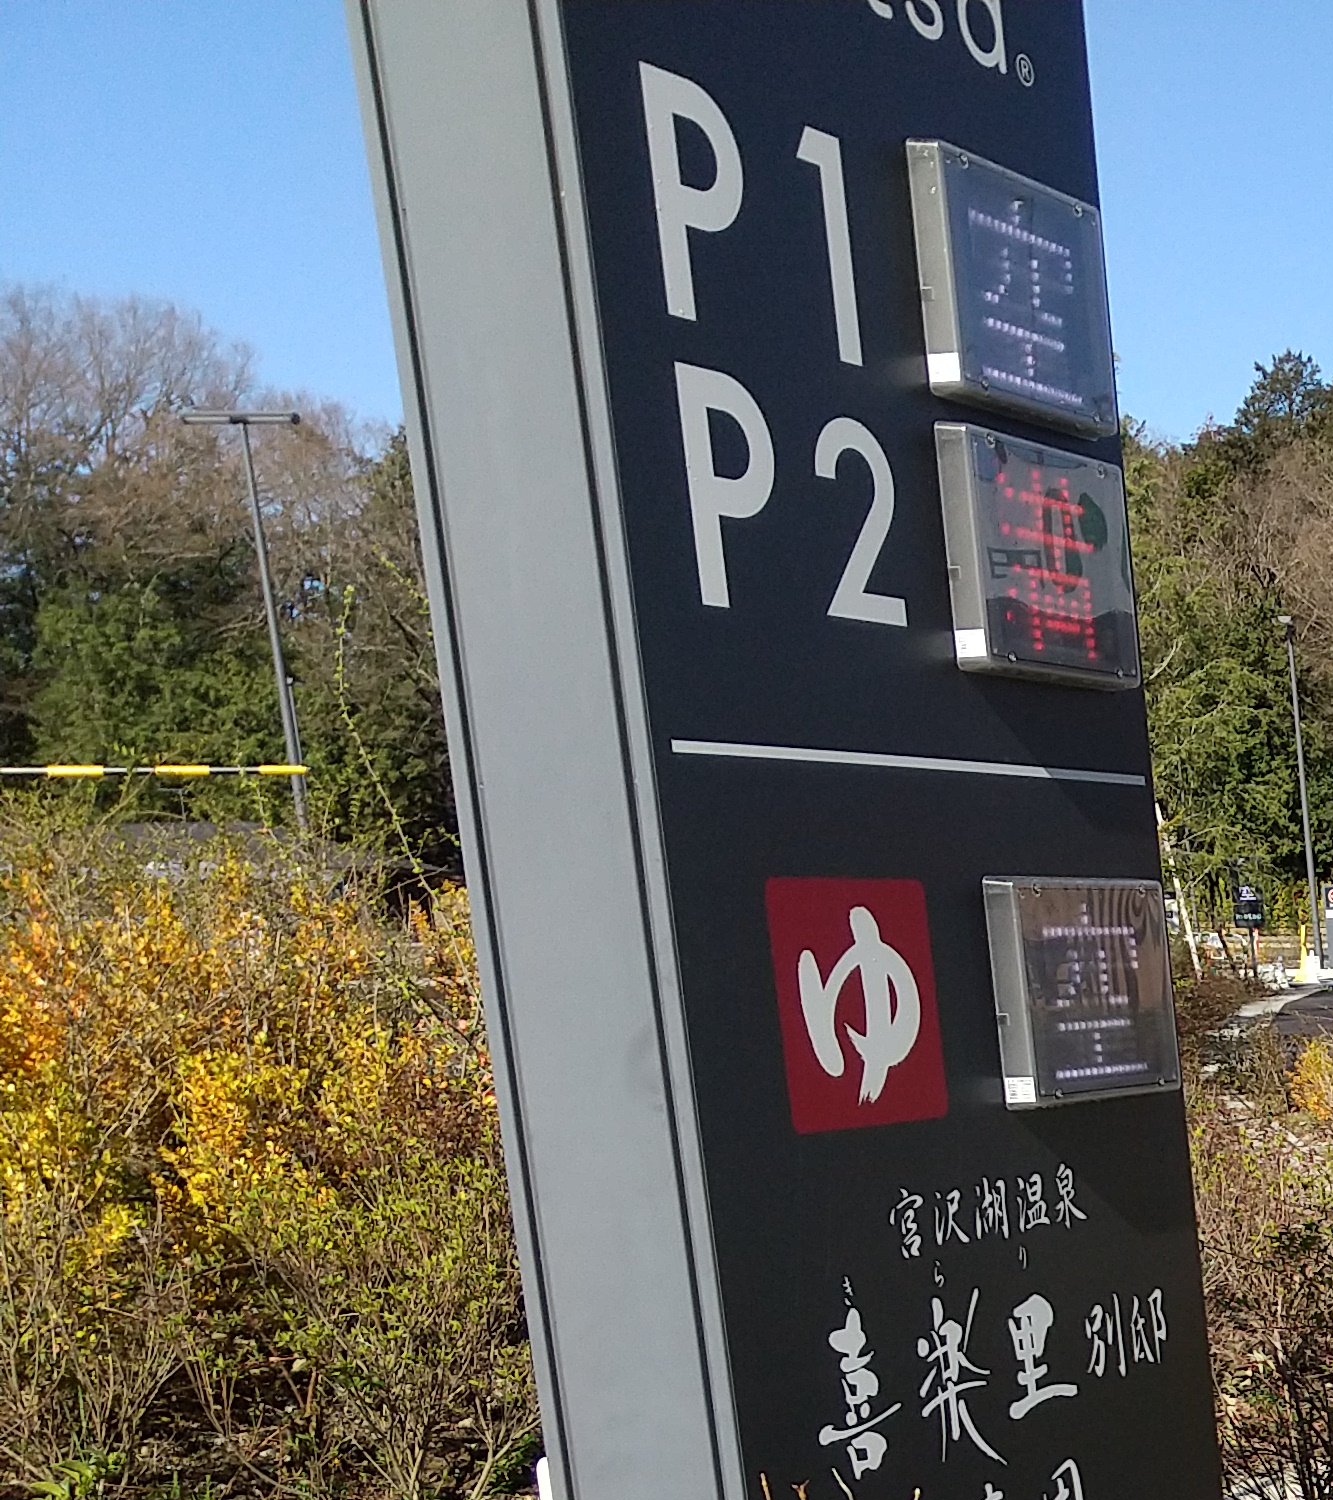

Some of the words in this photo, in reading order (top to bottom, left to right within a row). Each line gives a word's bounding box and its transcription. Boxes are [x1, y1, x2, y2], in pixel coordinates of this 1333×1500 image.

[798, 905, 921, 1107] ゆ
[889, 1163, 1088, 1260] 宮沢湖温泉
